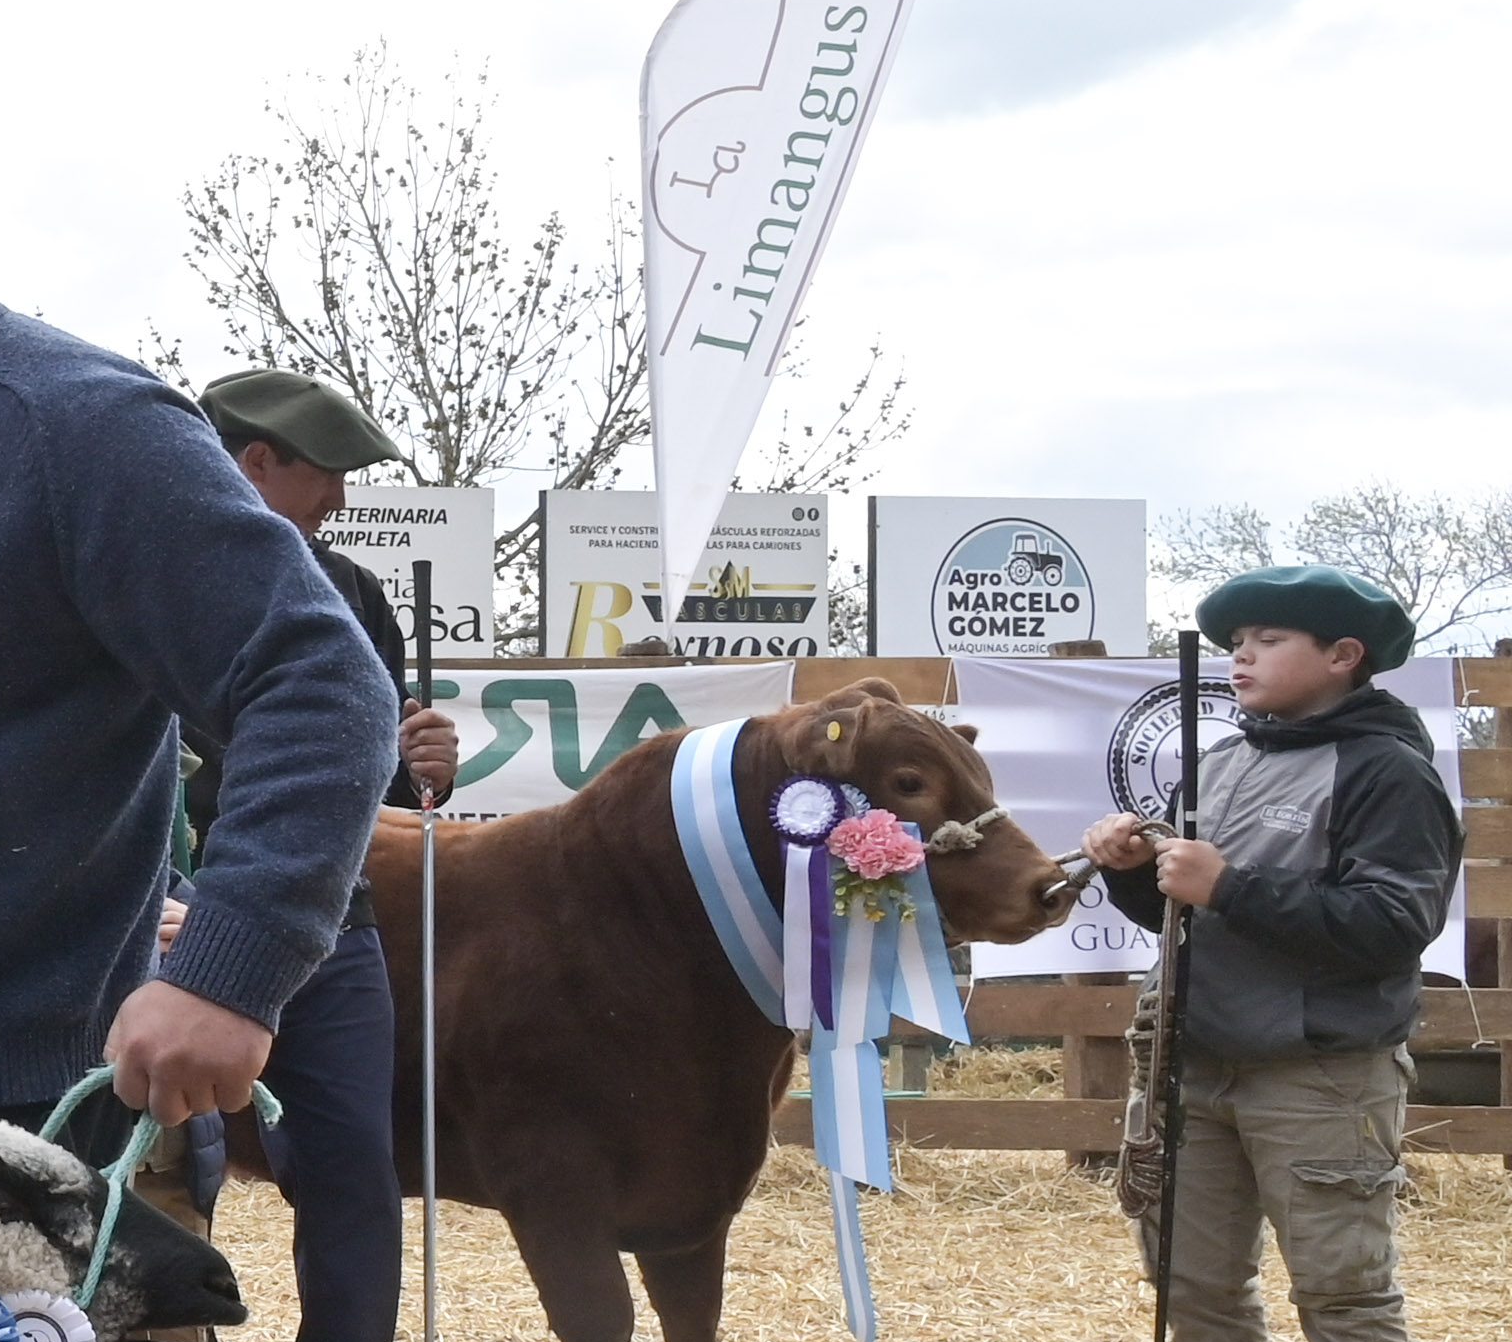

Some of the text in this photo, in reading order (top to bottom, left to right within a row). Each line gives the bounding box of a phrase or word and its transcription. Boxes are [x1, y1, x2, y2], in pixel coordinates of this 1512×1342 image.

[669, 140, 746, 198] La
[690, 6, 867, 362] Limangus
[569, 525, 608, 535] SERVICE
[760, 527, 821, 537] REFORZADAS
[589, 539, 613, 548] PARA
[726, 541, 749, 550] PARA
[753, 541, 802, 551] CAMIONES
[948, 568, 1002, 590] Agro
[948, 591, 1081, 613] MARCELO
[948, 612, 1046, 637] GÓMEZ
[948, 641, 1010, 654] MÁQUINAS
